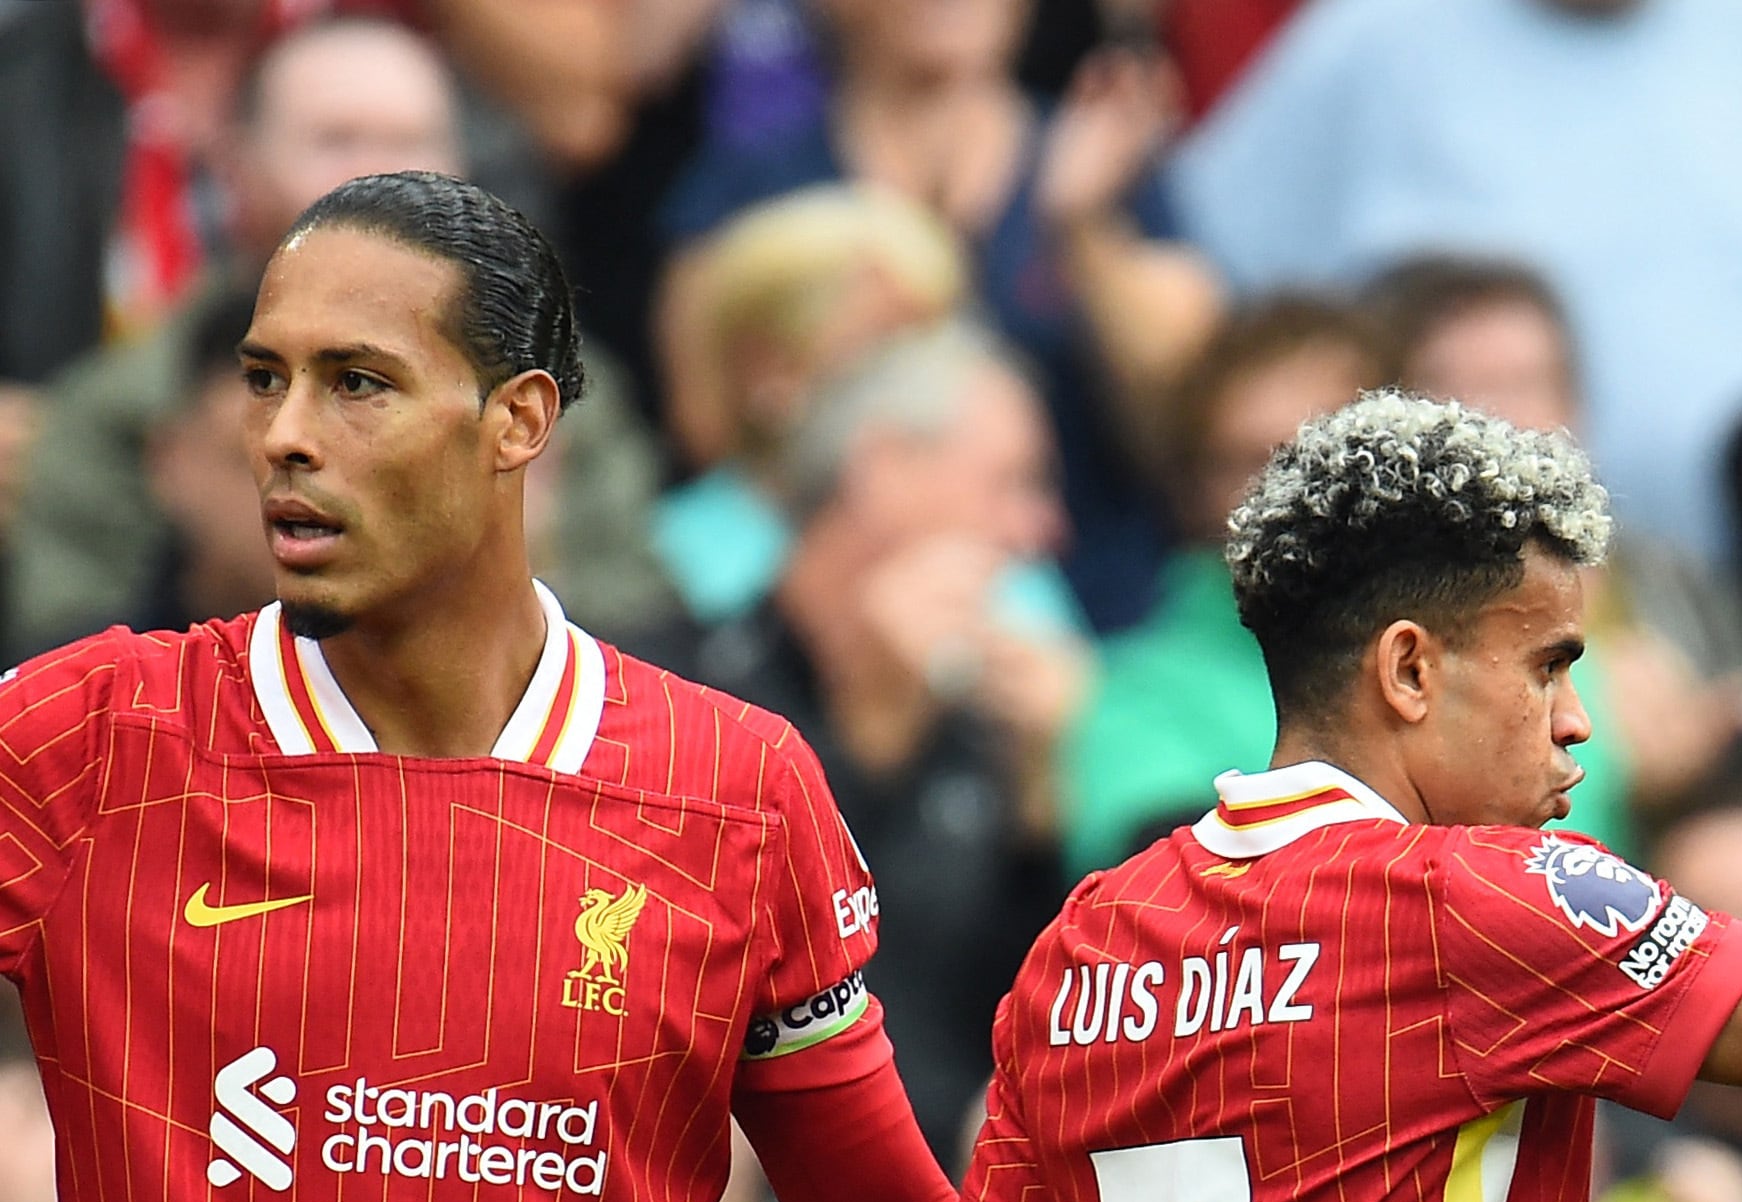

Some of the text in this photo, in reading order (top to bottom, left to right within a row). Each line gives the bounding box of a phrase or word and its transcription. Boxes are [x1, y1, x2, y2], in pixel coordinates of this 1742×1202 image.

[1050, 926, 1320, 1046] LUIS DÍAZ
[1618, 940, 1659, 982] No
[324, 1077, 598, 1145] standard
[321, 1126, 606, 1196] chartered
